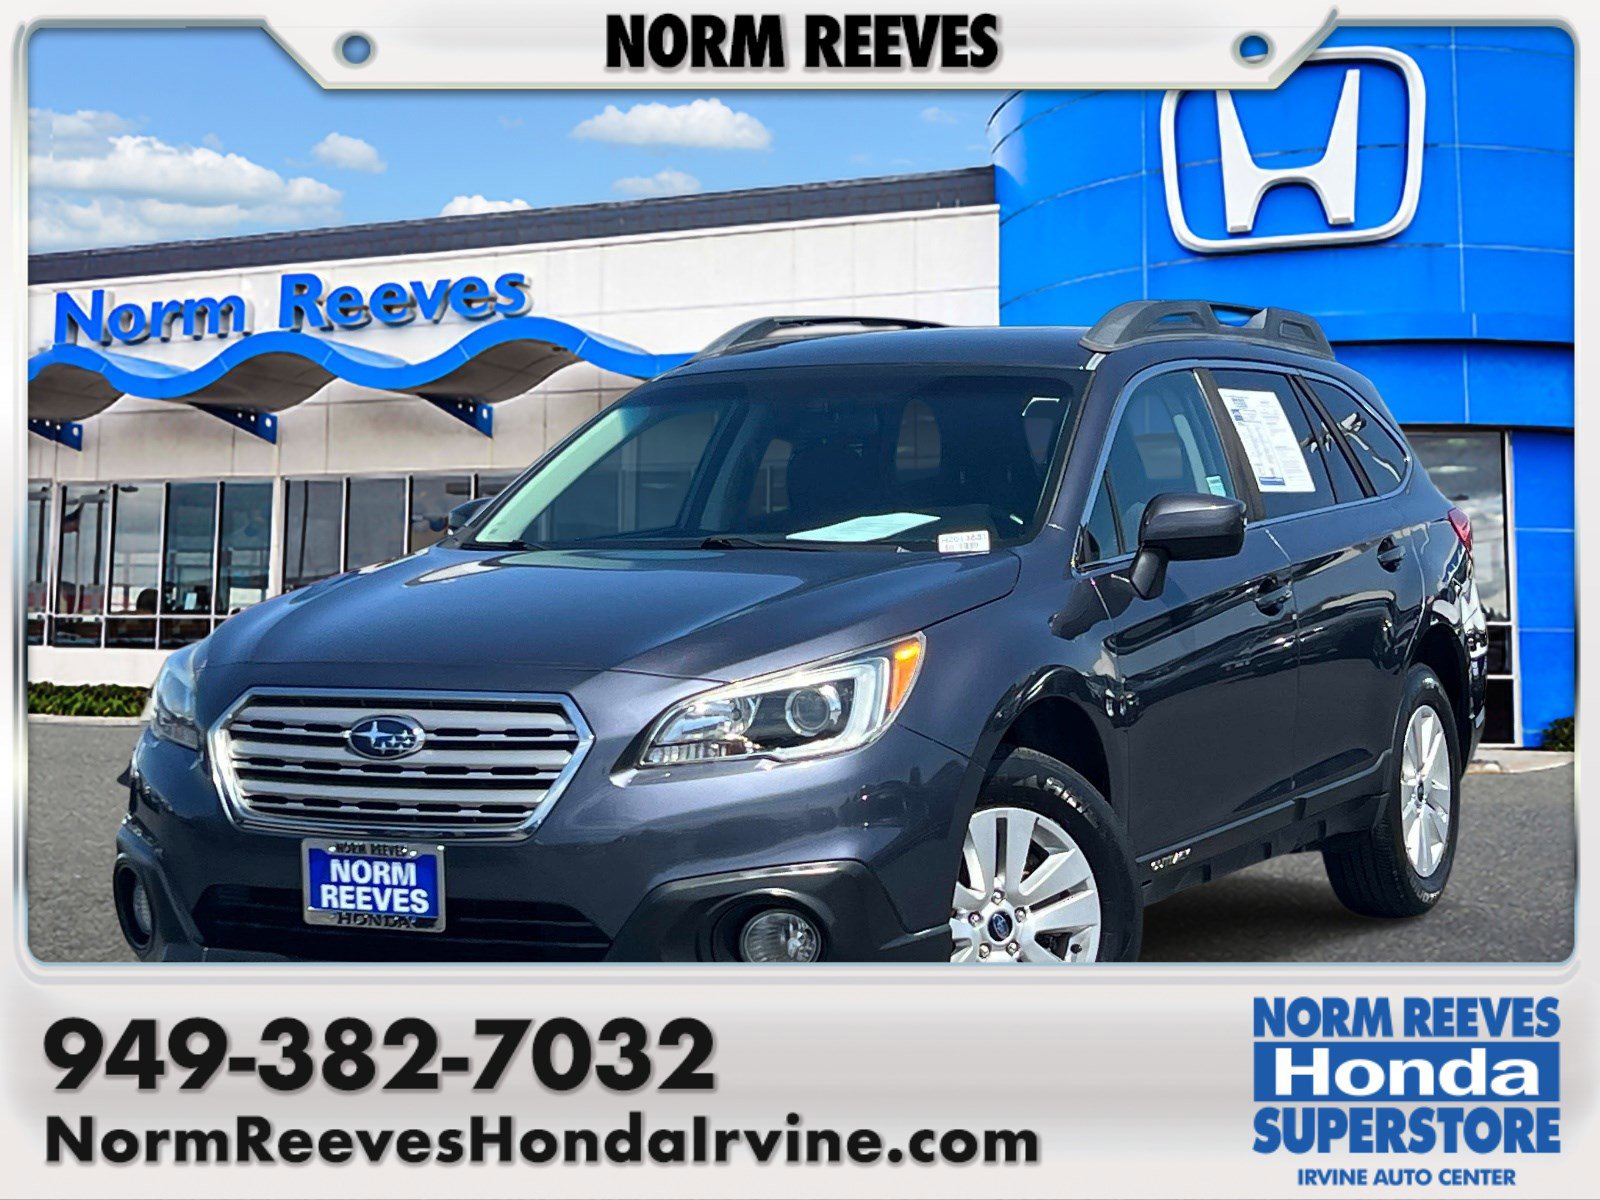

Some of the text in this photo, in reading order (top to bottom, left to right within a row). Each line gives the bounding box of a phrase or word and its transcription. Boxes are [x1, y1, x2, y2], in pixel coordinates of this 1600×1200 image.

[53, 272, 530, 346] Norm Reeves
[330, 859, 417, 886] NORM
[320, 884, 430, 913] REEVES
[337, 911, 415, 929] HONDA
